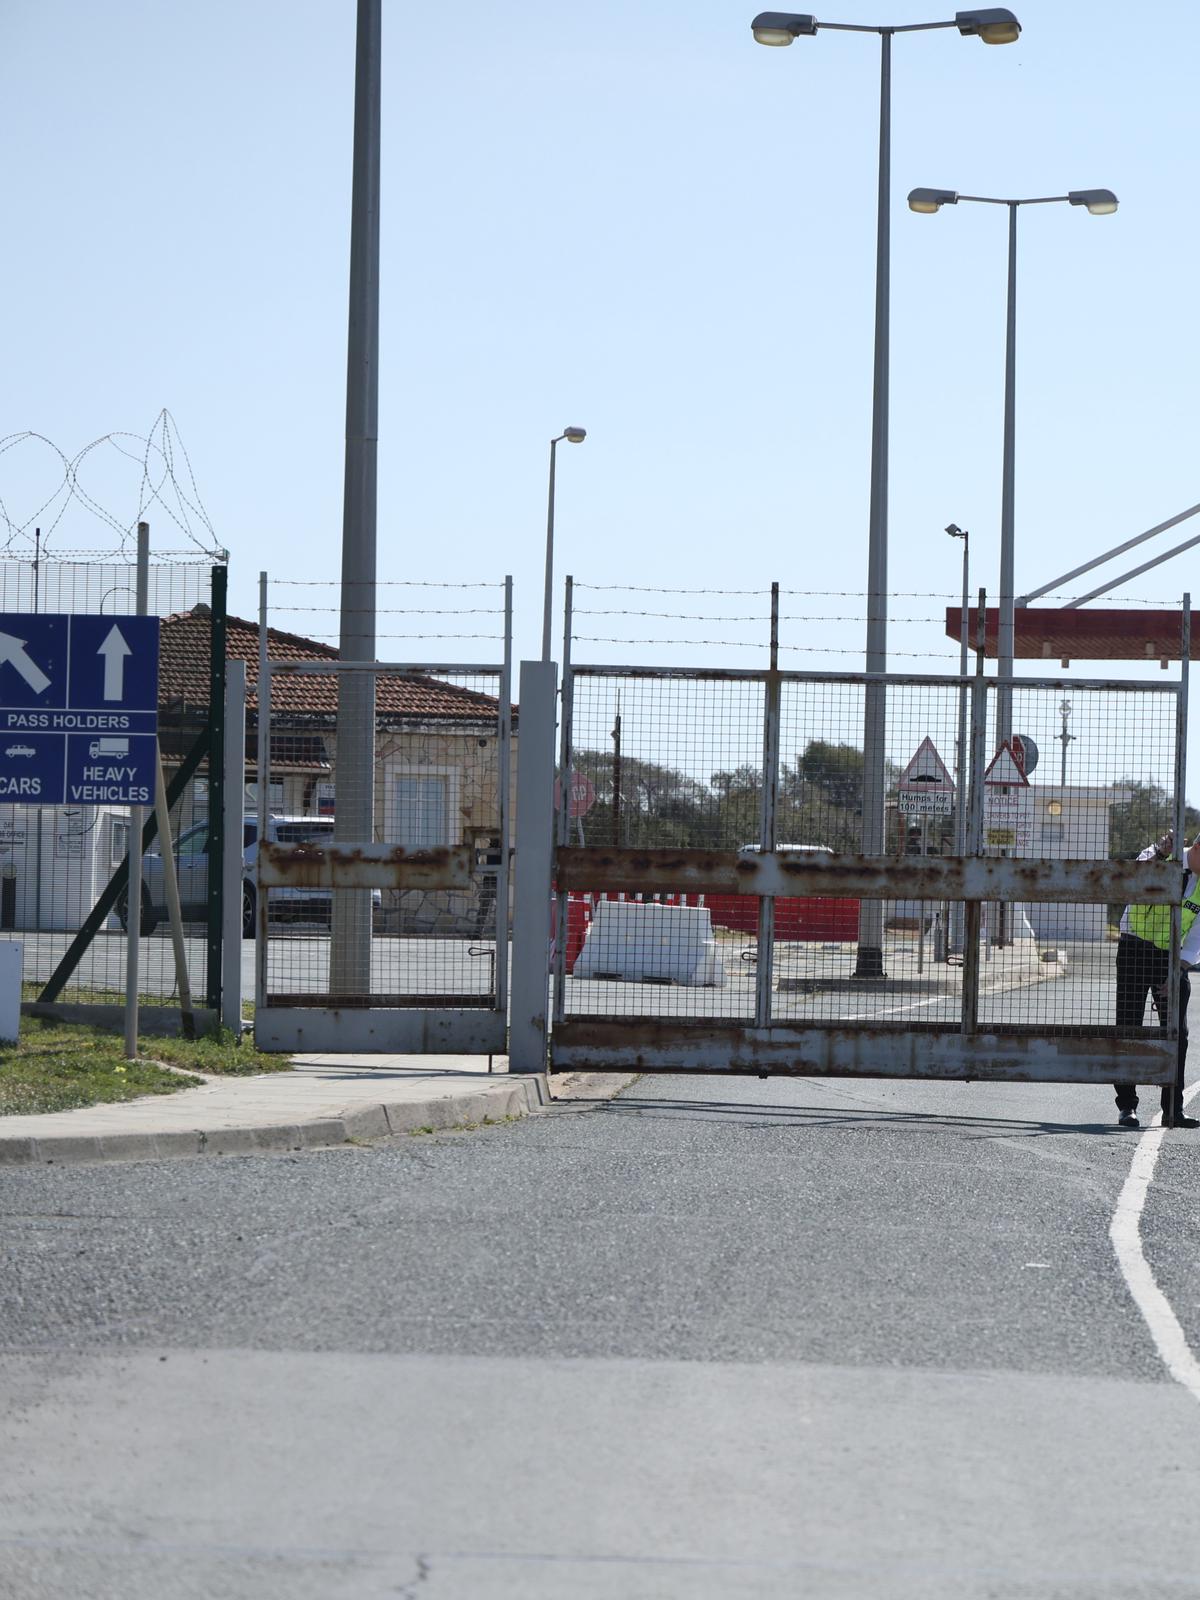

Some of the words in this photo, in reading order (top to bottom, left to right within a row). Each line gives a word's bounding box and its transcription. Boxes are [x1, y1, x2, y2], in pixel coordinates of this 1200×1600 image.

[7, 714, 49, 727] PASS
[53, 714, 130, 728] HOLDERS
[83, 766, 138, 782] HEAVY
[0, 776, 41, 795] CARS
[71, 785, 150, 801] VEHICLES
[901, 793, 932, 803] Humps
[936, 794, 948, 802] for
[900, 803, 916, 811] 100
[988, 796, 1019, 805] NOTICE
